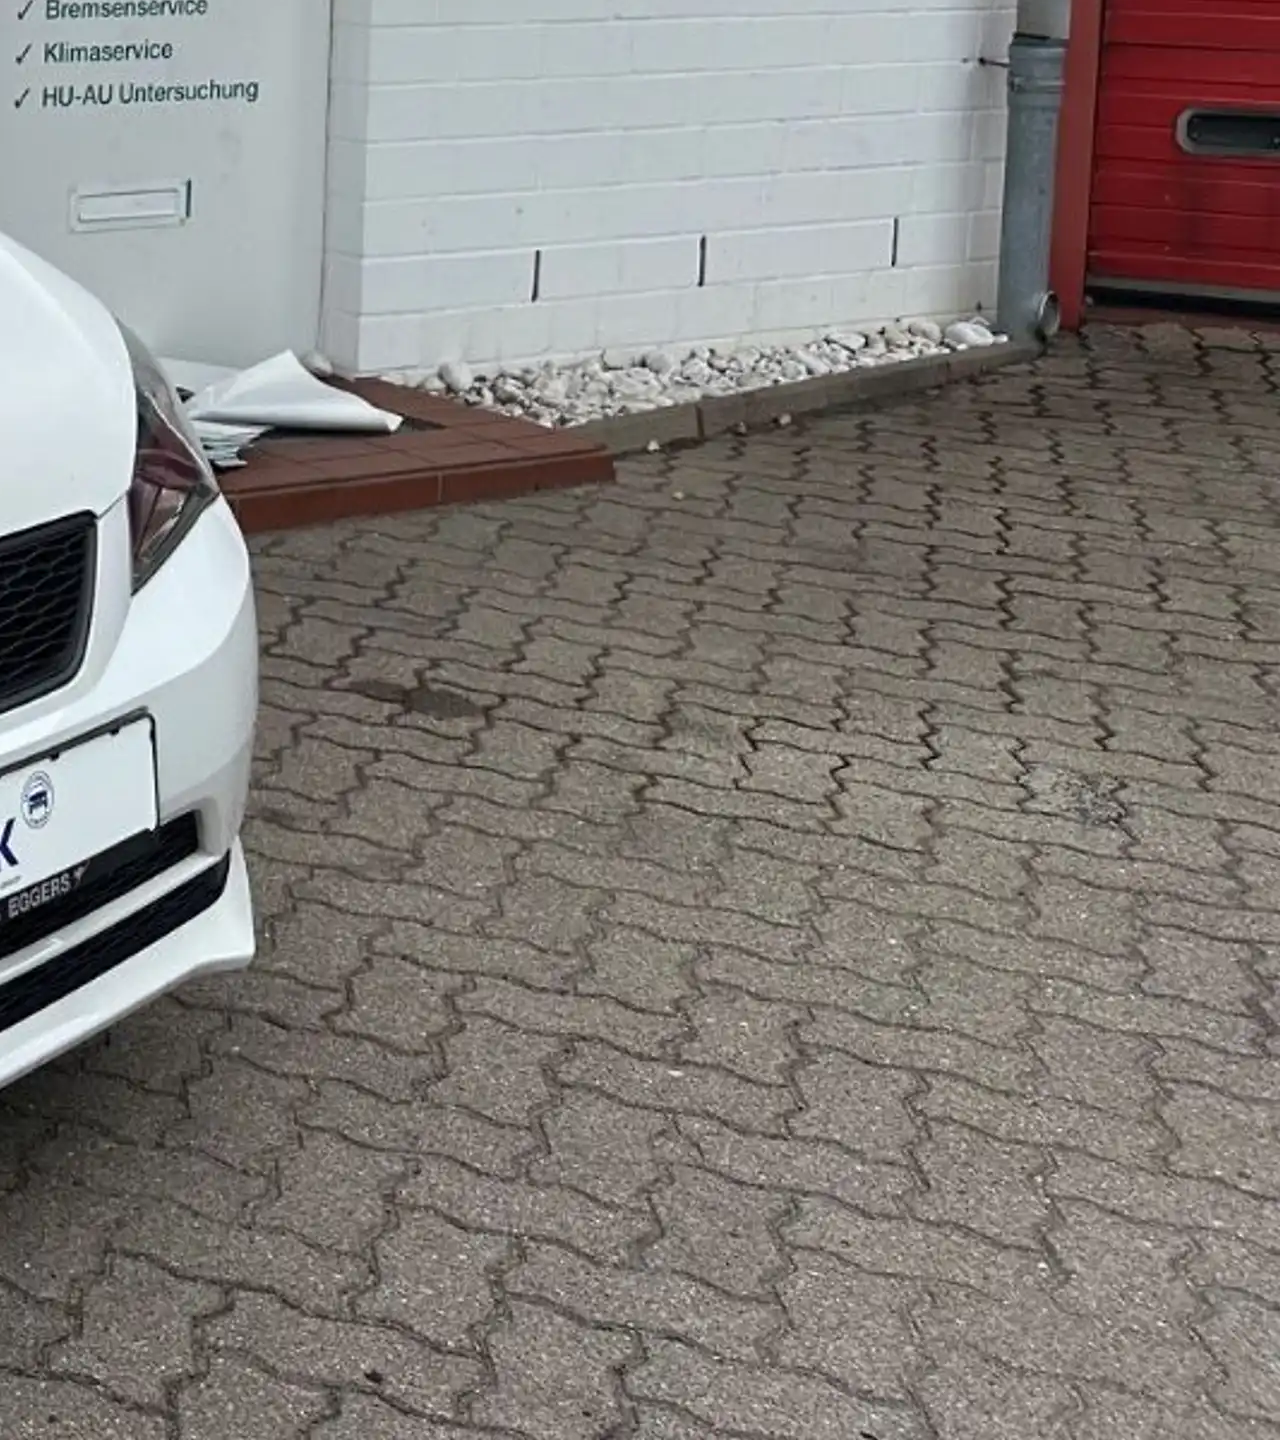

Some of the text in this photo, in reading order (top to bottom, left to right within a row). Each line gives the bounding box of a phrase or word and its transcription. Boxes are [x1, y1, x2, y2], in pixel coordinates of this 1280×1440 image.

[42, 40, 174, 64] Klimaservice
[41, 79, 260, 108] HU-AU Untersuchung
[7, 872, 72, 919] EGGERS
